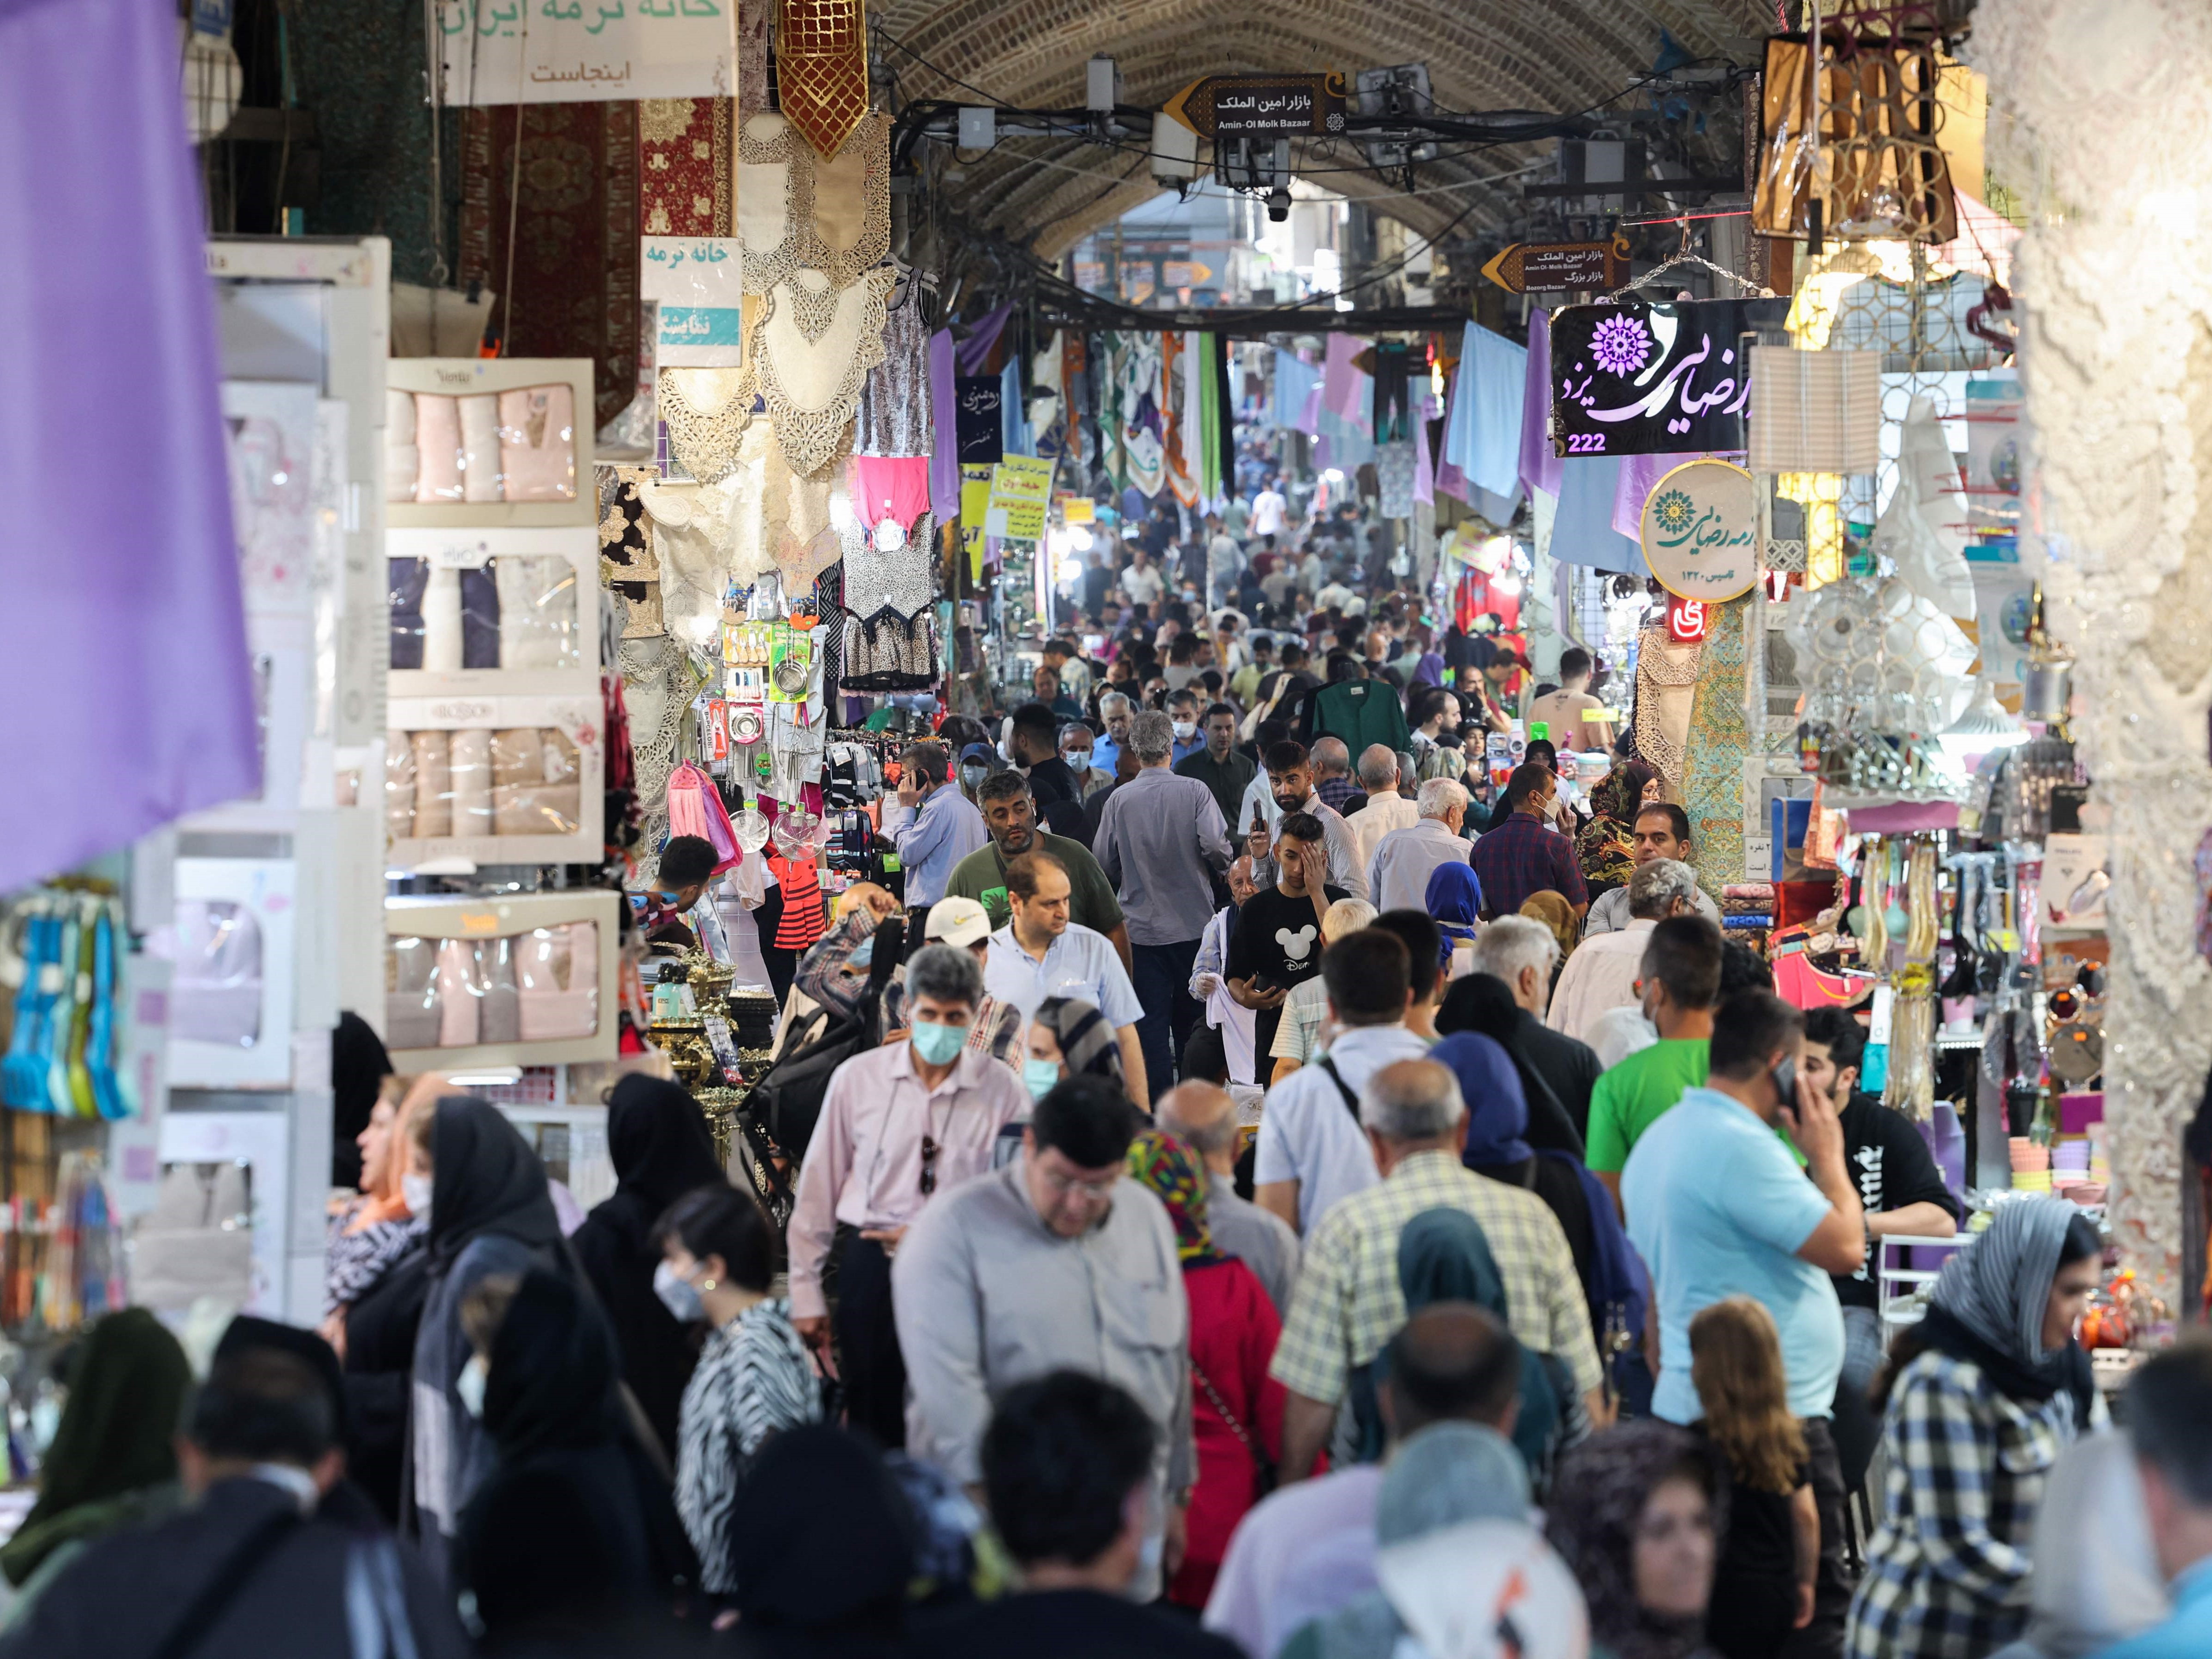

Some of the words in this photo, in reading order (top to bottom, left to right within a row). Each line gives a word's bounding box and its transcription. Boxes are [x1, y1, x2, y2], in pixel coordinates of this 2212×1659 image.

[530, 61, 630, 88] اینجاست
[1217, 96, 1255, 109] الملک
[1258, 95, 1285, 112] امین
[1287, 95, 1312, 111] بازار
[1258, 120, 1279, 129] Molk
[1280, 119, 1311, 128] Bazaar
[647, 242, 685, 268] ترمه
[692, 241, 728, 263] خانه
[1537, 252, 1564, 261] الملک
[1566, 251, 1585, 263] امین
[1586, 250, 1604, 261] بازار
[1564, 271, 1585, 283] بزرگ
[1586, 271, 1604, 282] بازار
[1561, 362, 1595, 406] یزد
[1568, 433, 1606, 452] 222
[1656, 505, 1729, 555] رضایی
[1727, 515, 1754, 547] رمه
[1682, 571, 1704, 580] ۱۳۲۰
